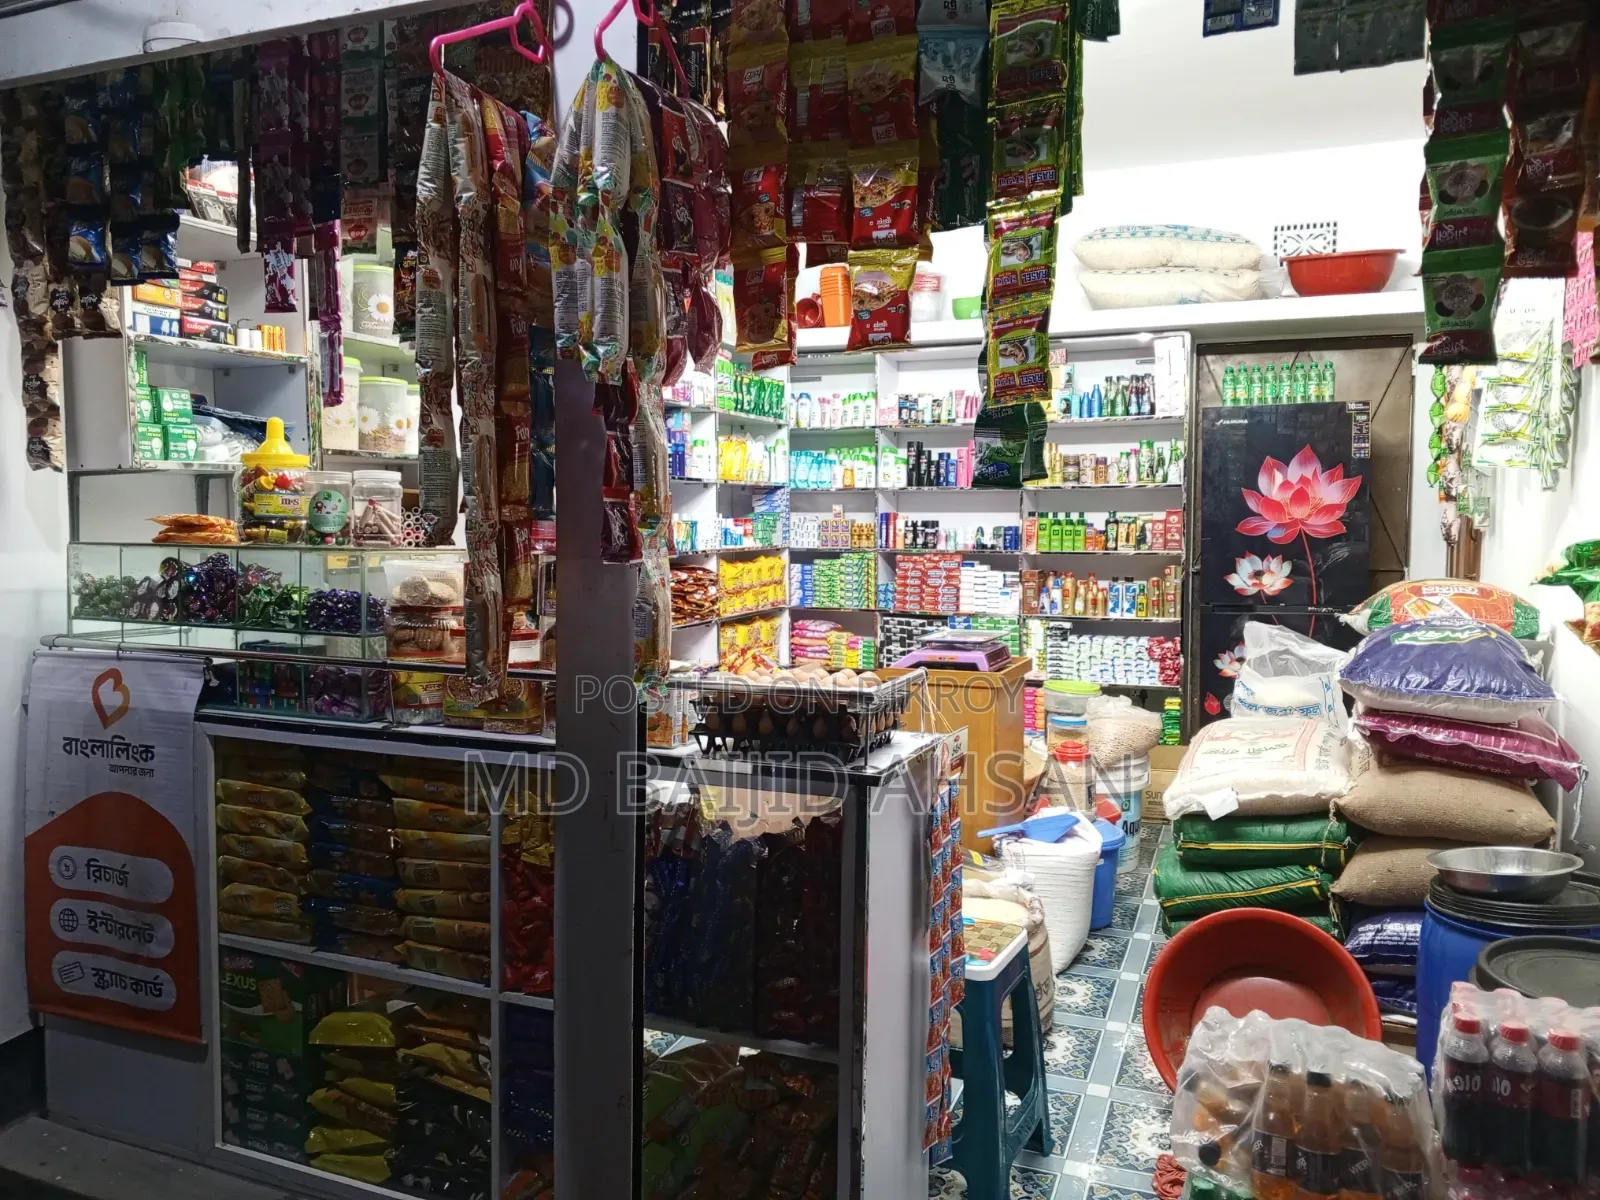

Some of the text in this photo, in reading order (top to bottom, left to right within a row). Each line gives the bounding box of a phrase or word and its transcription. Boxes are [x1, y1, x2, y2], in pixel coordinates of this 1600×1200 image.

[1028, 169, 1056, 183] RASEL
[776, 192, 786, 216] Fresh
[1021, 268, 1048, 284] RASEL
[776, 293, 786, 317] Fresh
[510, 317, 526, 336] Fun
[1018, 371, 1044, 387] RASEL
[515, 423, 530, 442] Fun
[62, 734, 156, 765] বাংলালিংক
[108, 763, 154, 778] আপনার জন্য
[84, 857, 130, 890] রিচার্জ
[86, 907, 154, 946] ইন্টারনেট
[129, 973, 164, 1000] কার্ড
